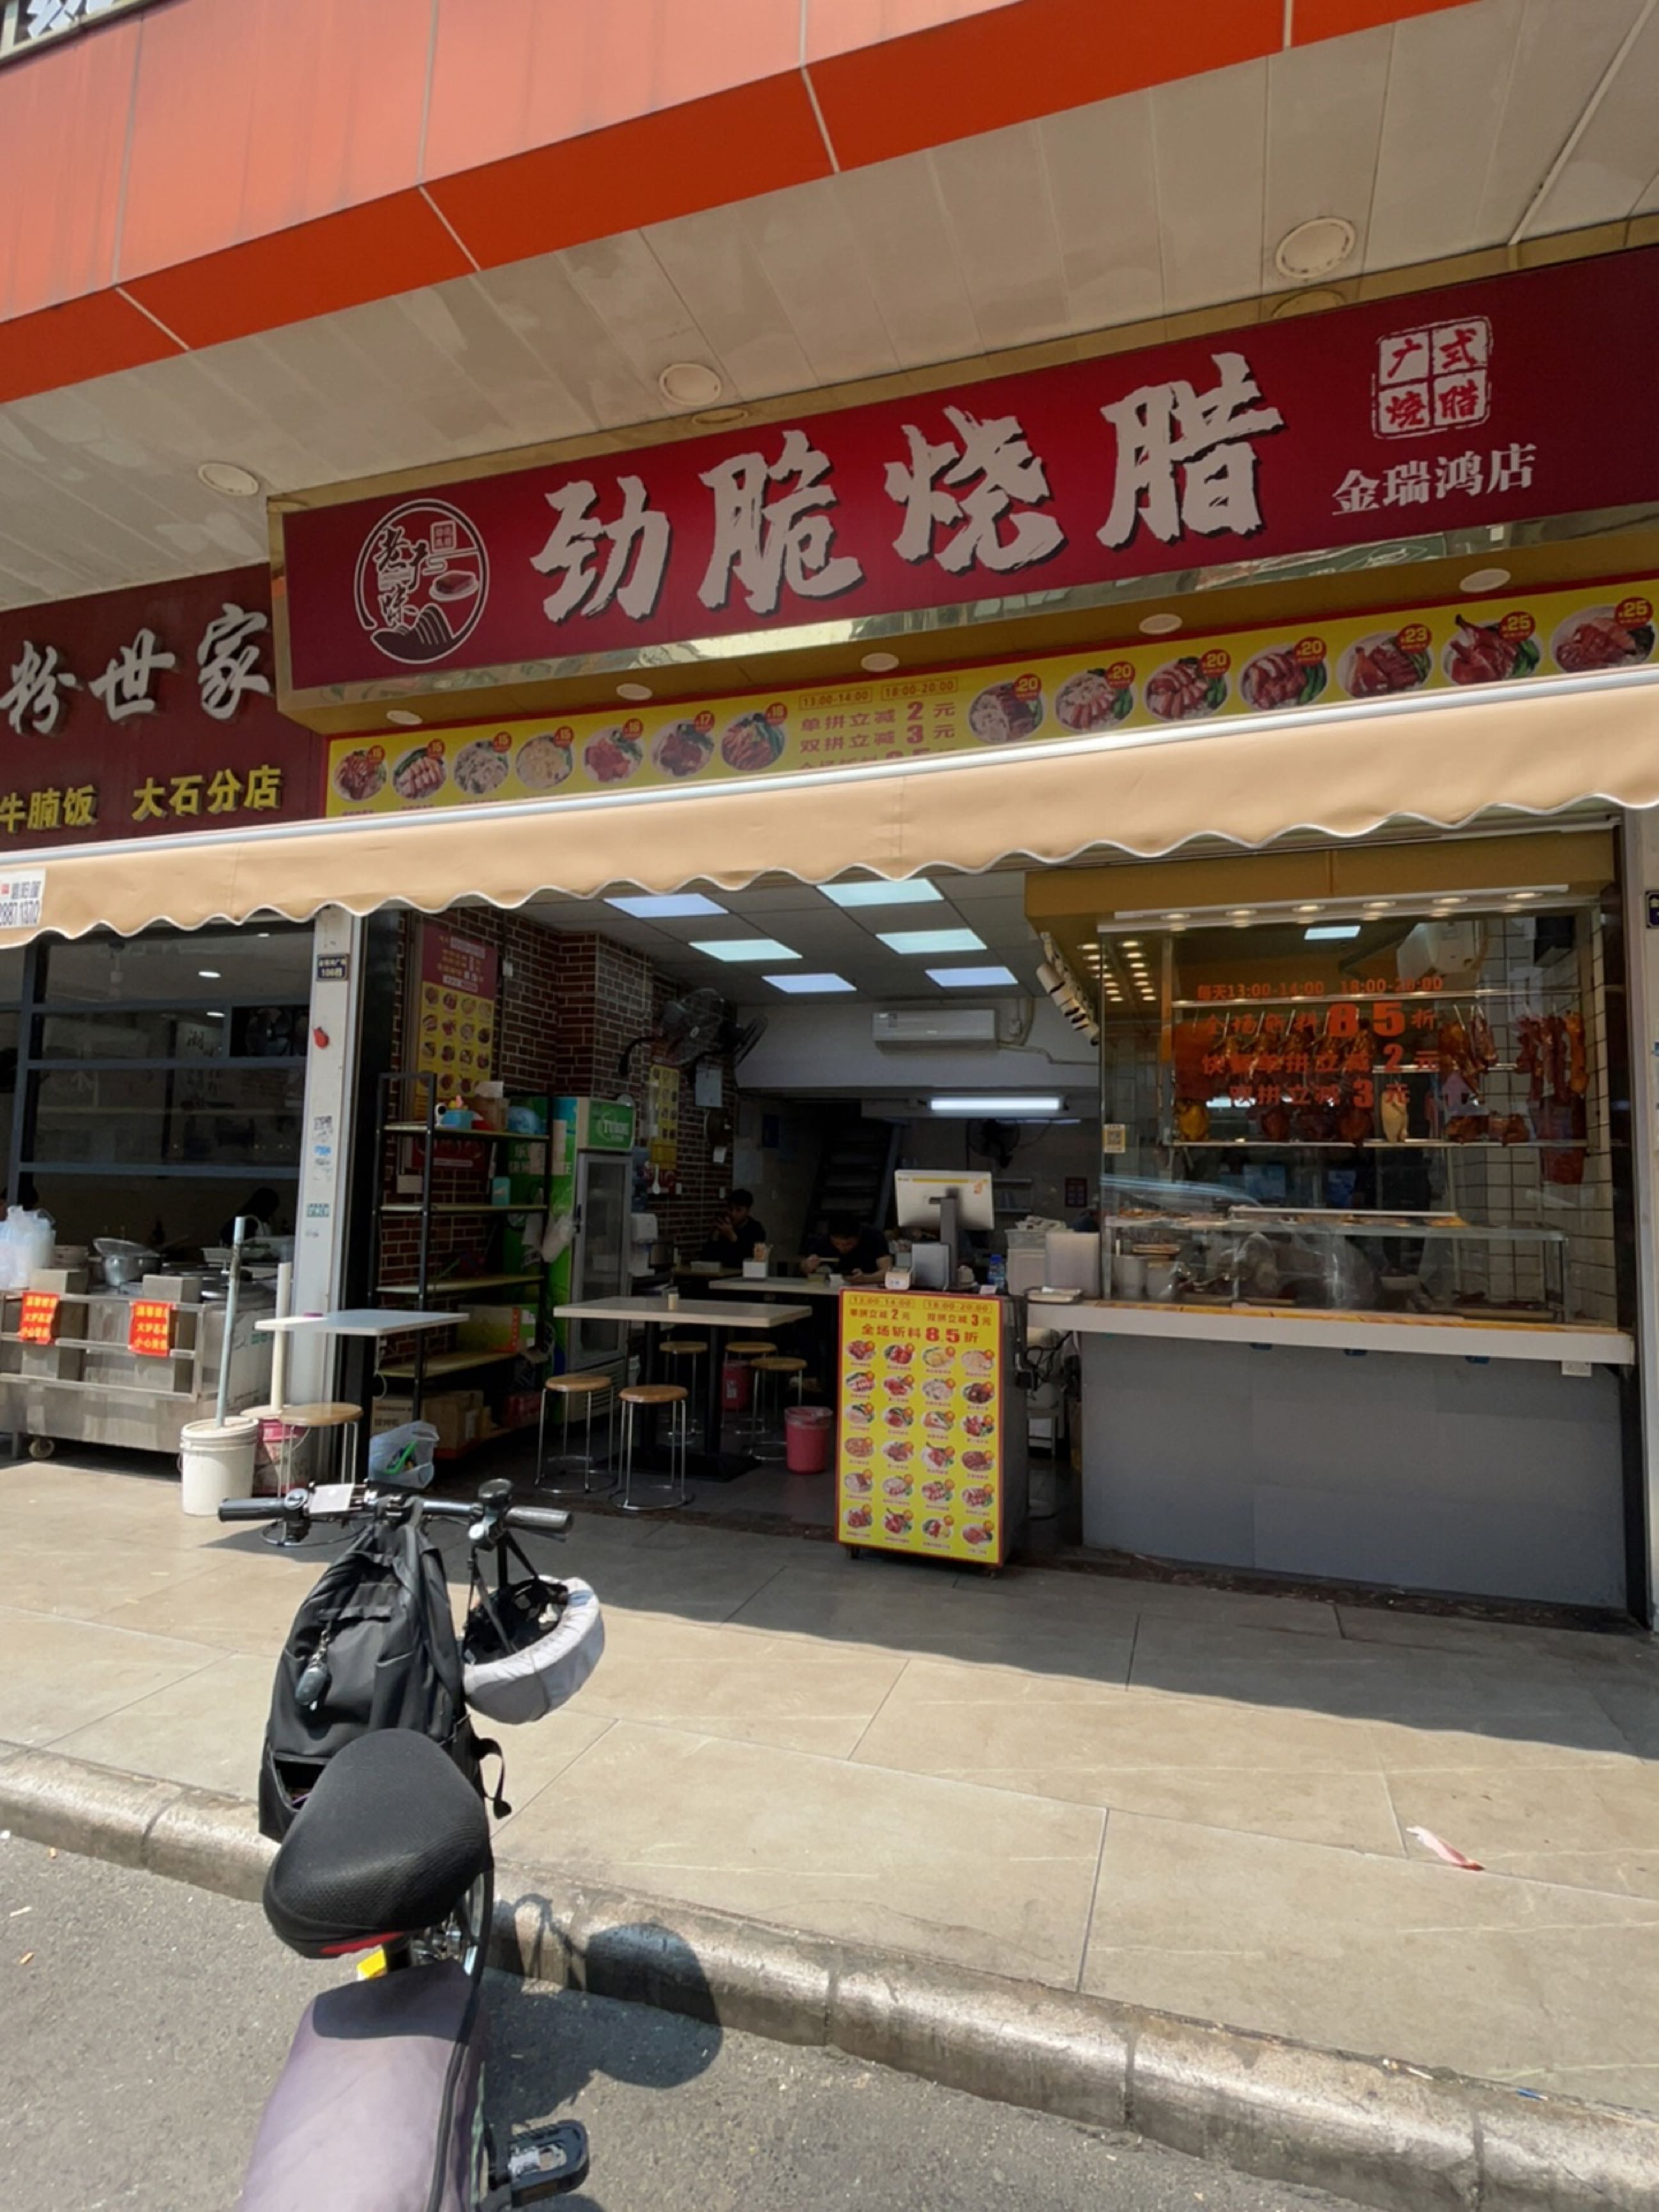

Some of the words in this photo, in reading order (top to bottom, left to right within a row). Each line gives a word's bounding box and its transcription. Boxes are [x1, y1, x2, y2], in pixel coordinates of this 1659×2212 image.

[1386, 327, 1477, 379] 广式
[530, 351, 1285, 623] 劲脆烧腊
[1332, 443, 1537, 516] 金瑞鸿店
[0, 603, 270, 735] 粉世家
[0, 784, 95, 832] 牛腩饭
[132, 764, 282, 821] 大石分店
